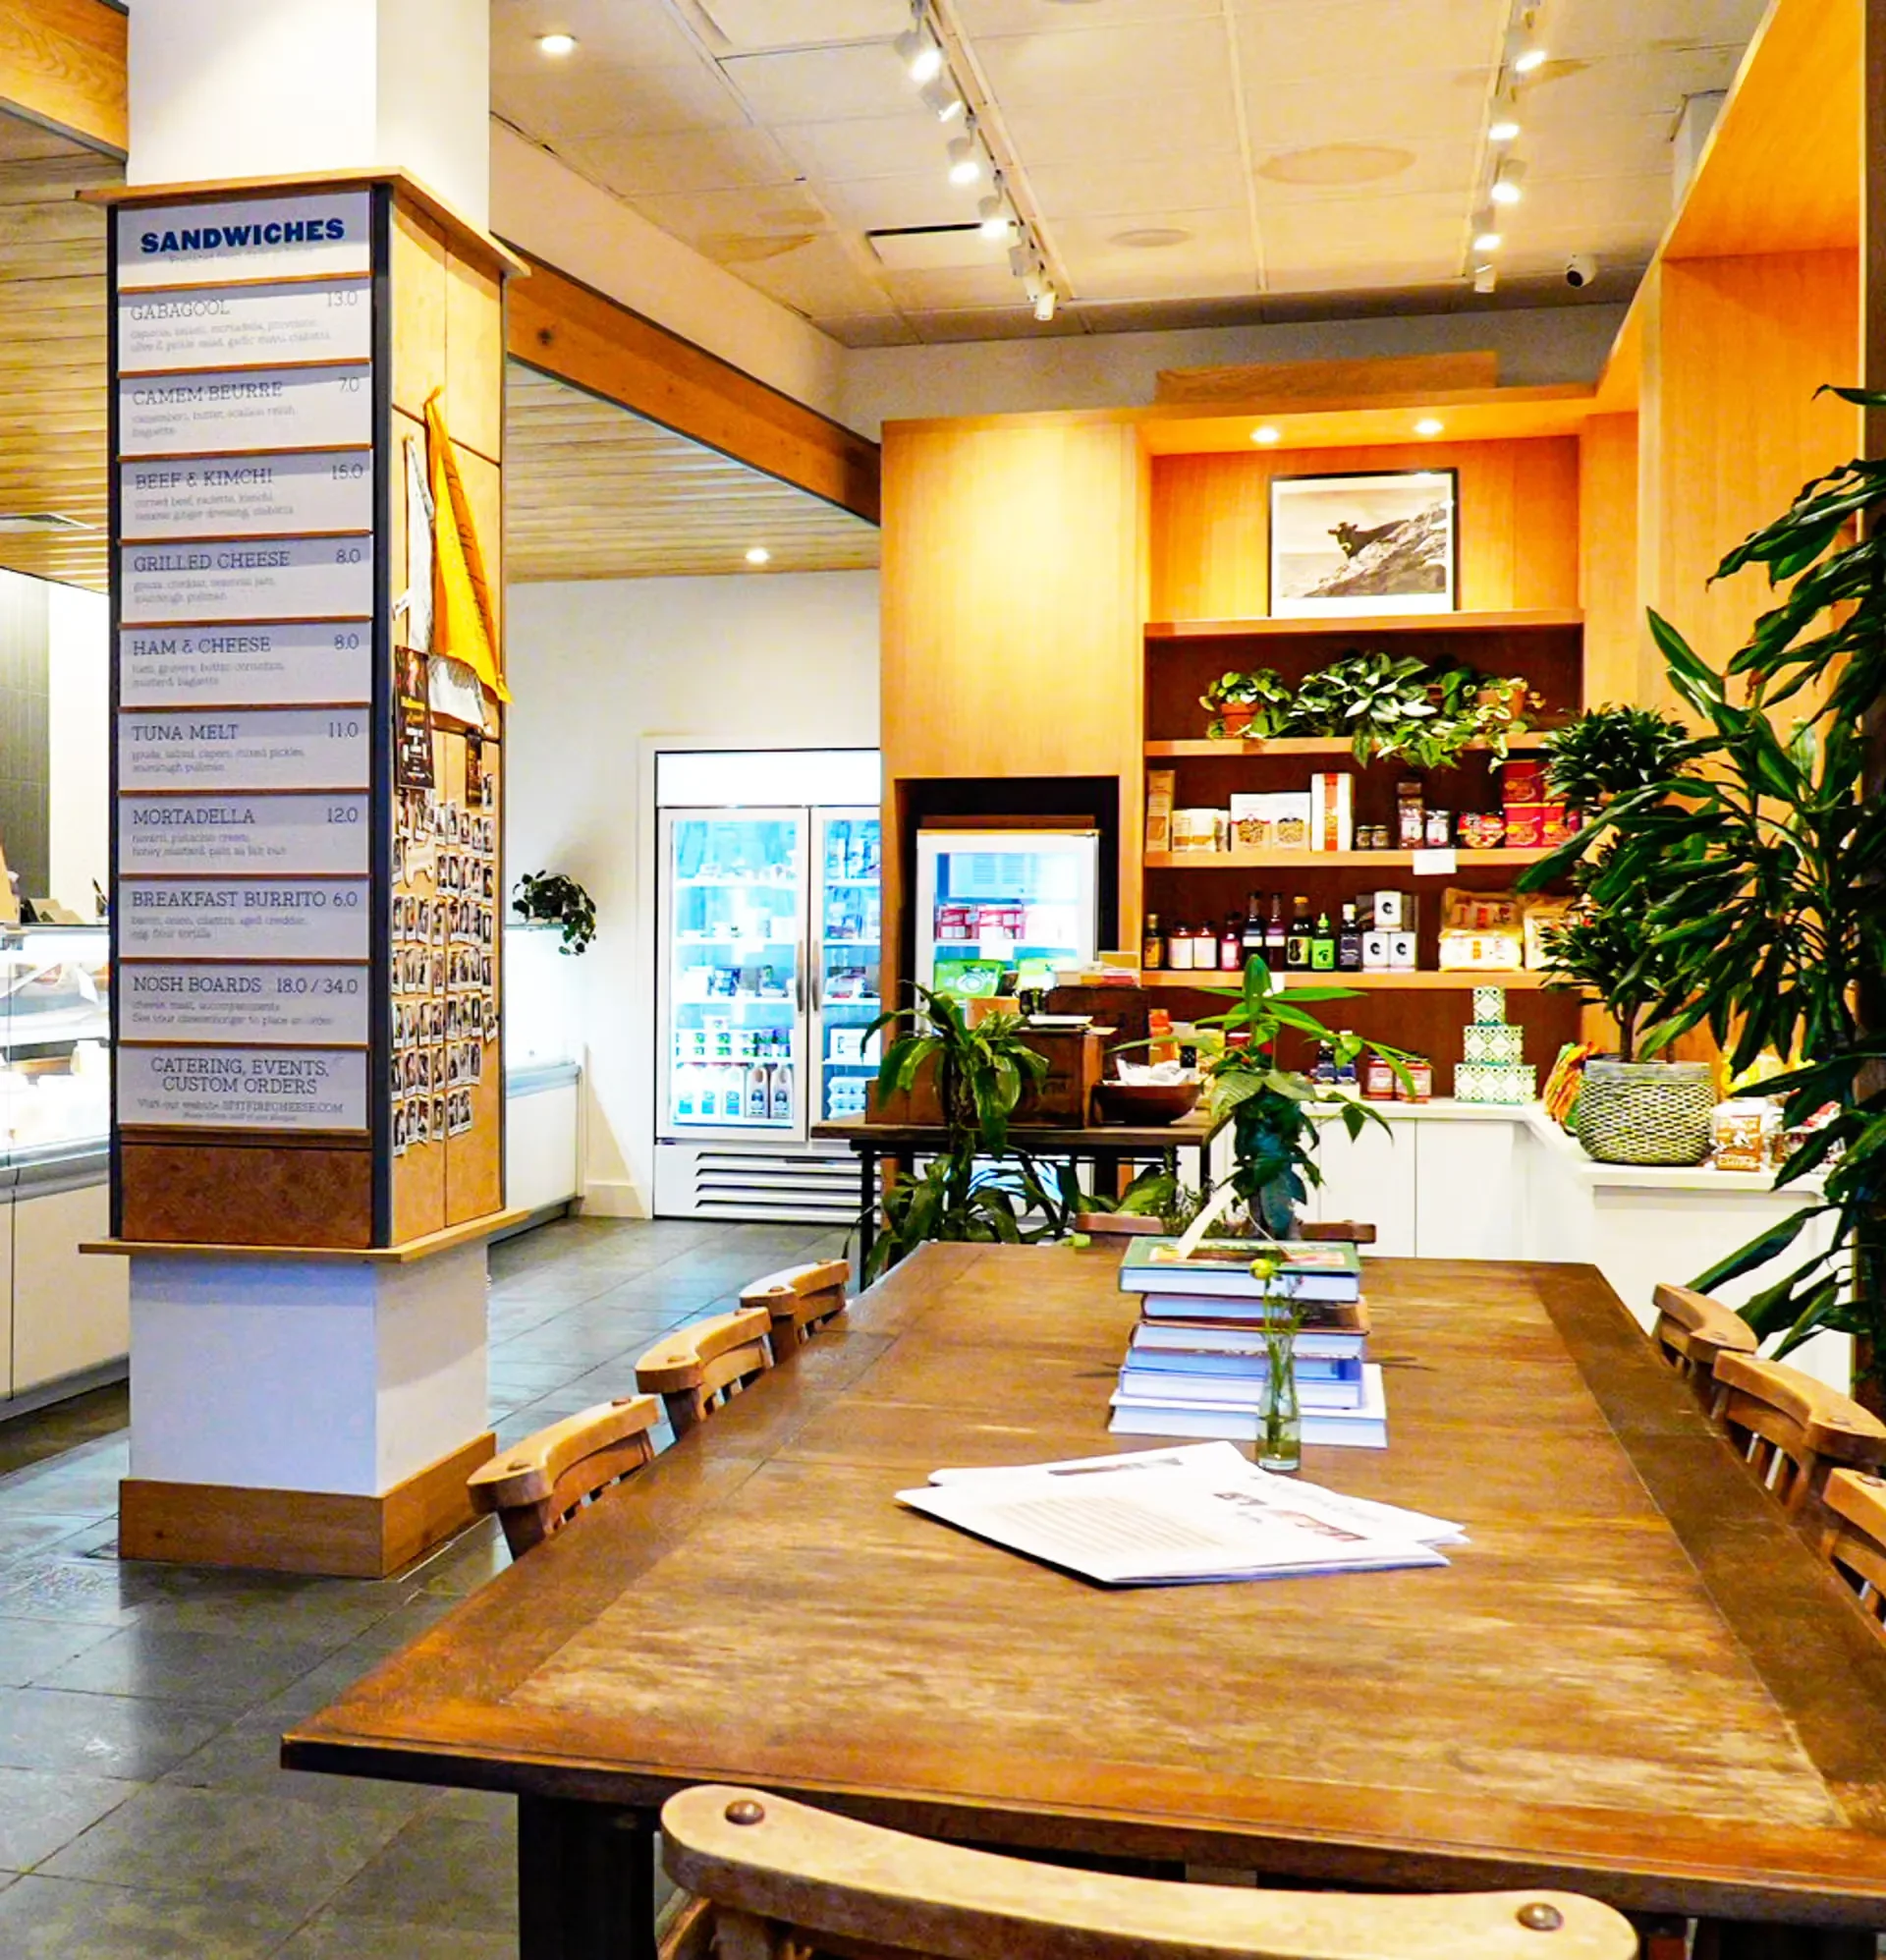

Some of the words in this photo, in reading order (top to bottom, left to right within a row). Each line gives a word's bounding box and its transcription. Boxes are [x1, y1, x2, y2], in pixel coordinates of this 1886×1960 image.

[140, 218, 345, 253] SANDWICHES
[131, 299, 231, 321] GABAGOOL
[326, 291, 359, 308] 13.0
[133, 386, 203, 405] CAMEM
[208, 381, 283, 401] BEURRE
[136, 473, 182, 490] BEEF
[187, 472, 197, 487] &
[203, 468, 273, 487] KIMCHI
[332, 463, 363, 480] 15.0
[134, 553, 212, 573] GRILLED
[217, 550, 291, 569] CHEESE
[335, 548, 361, 564] 8.0
[133, 640, 177, 656] HAM
[182, 639, 194, 654] &
[198, 637, 272, 654] CHEESE
[334, 634, 360, 650] 8.0
[132, 725, 184, 741] TUNA
[190, 723, 240, 740] MELT
[328, 721, 359, 738] 11.0
[133, 809, 255, 825] MORTADELLA
[326, 807, 359, 823] 12.0
[132, 890, 239, 908] BREAKFAST
[244, 890, 327, 908] BURRITO
[332, 890, 359, 908] 6.0
[133, 977, 184, 992] NOSH
[189, 977, 262, 993] BOARDS
[276, 978, 307, 994] 18.0
[310, 979, 318, 993] /
[323, 979, 359, 994] 34.0
[150, 1056, 246, 1076] CATERING,
[251, 1059, 329, 1077] EVENTS,
[162, 1076, 238, 1092] CUSTOM
[244, 1078, 317, 1094] ORDERS
